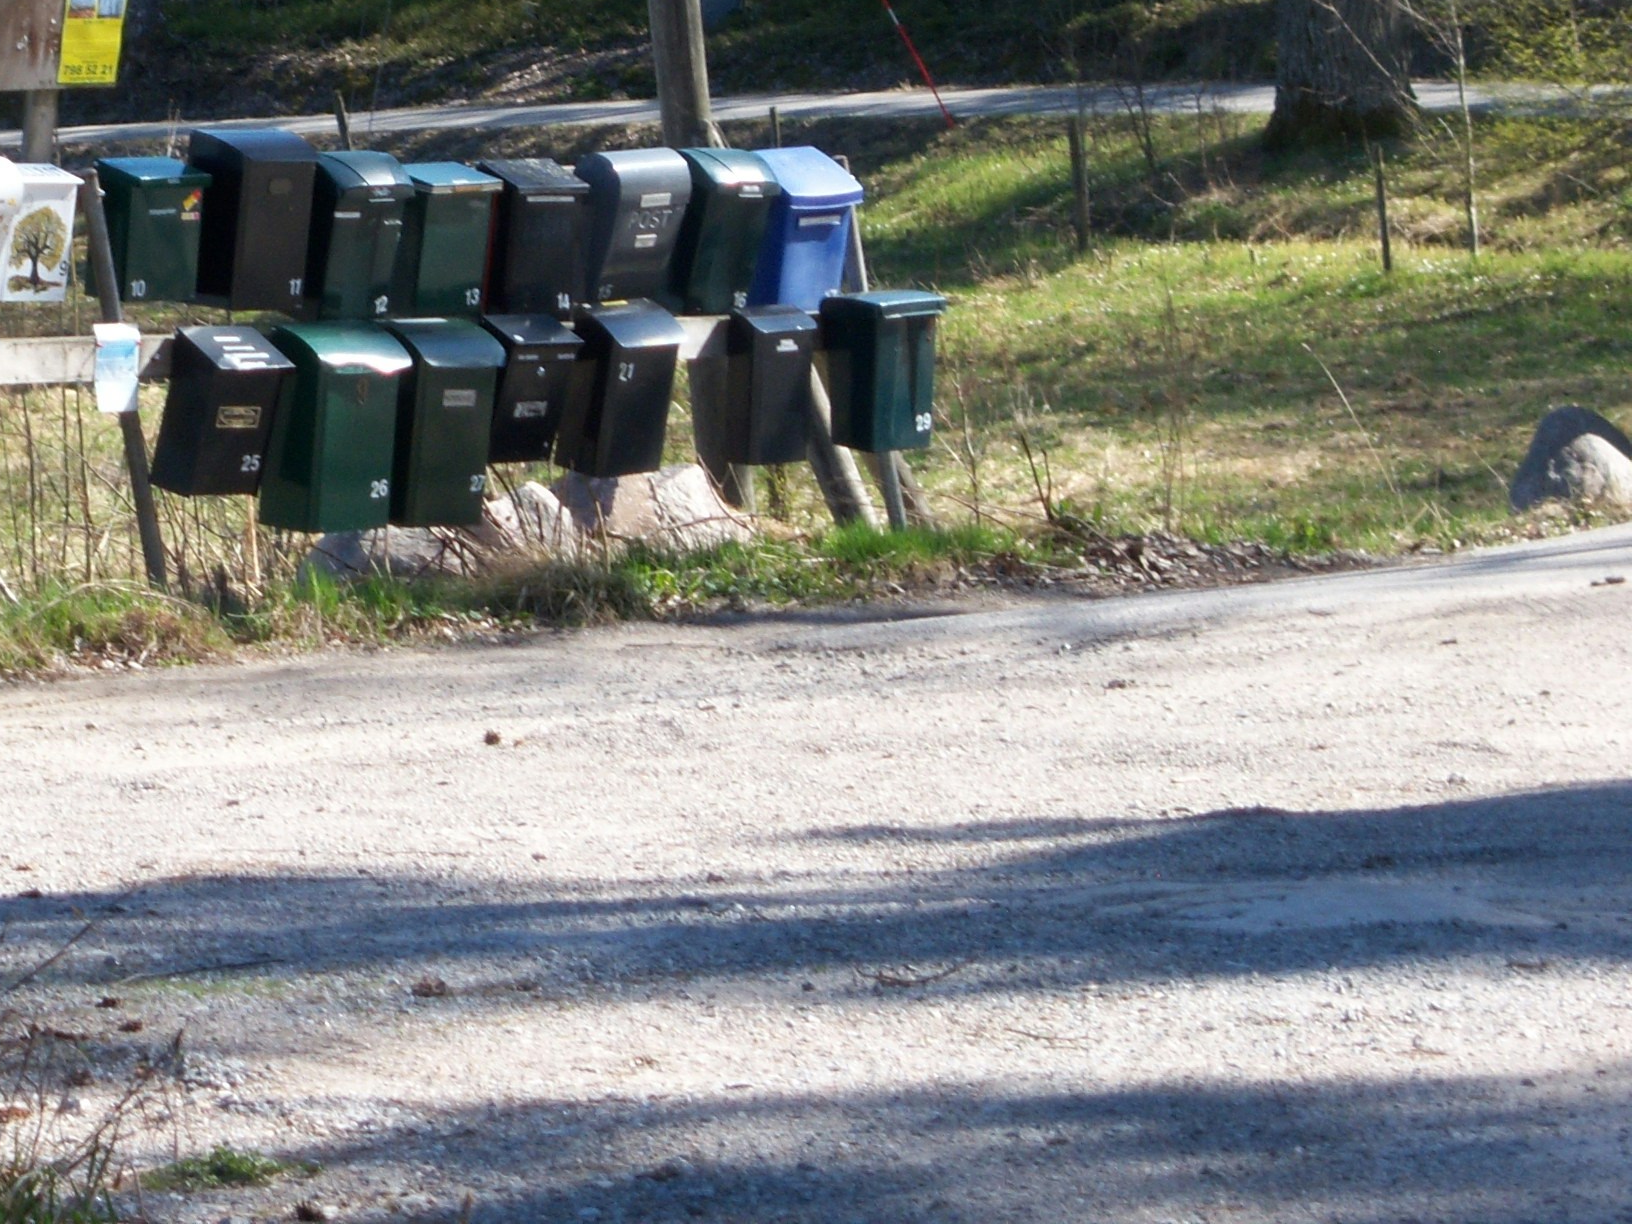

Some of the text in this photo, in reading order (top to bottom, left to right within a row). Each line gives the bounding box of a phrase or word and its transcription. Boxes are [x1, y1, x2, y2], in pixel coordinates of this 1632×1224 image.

[628, 209, 672, 229] POST
[59, 260, 68, 276] 9
[130, 279, 146, 297] 10
[289, 278, 302, 296] 11
[465, 287, 480, 306] 13
[374, 295, 388, 314] 12
[618, 361, 634, 382] 21
[915, 412, 931, 432] 29
[241, 455, 261, 471] 25
[370, 478, 389, 499] 26
[470, 474, 486, 492] 27
